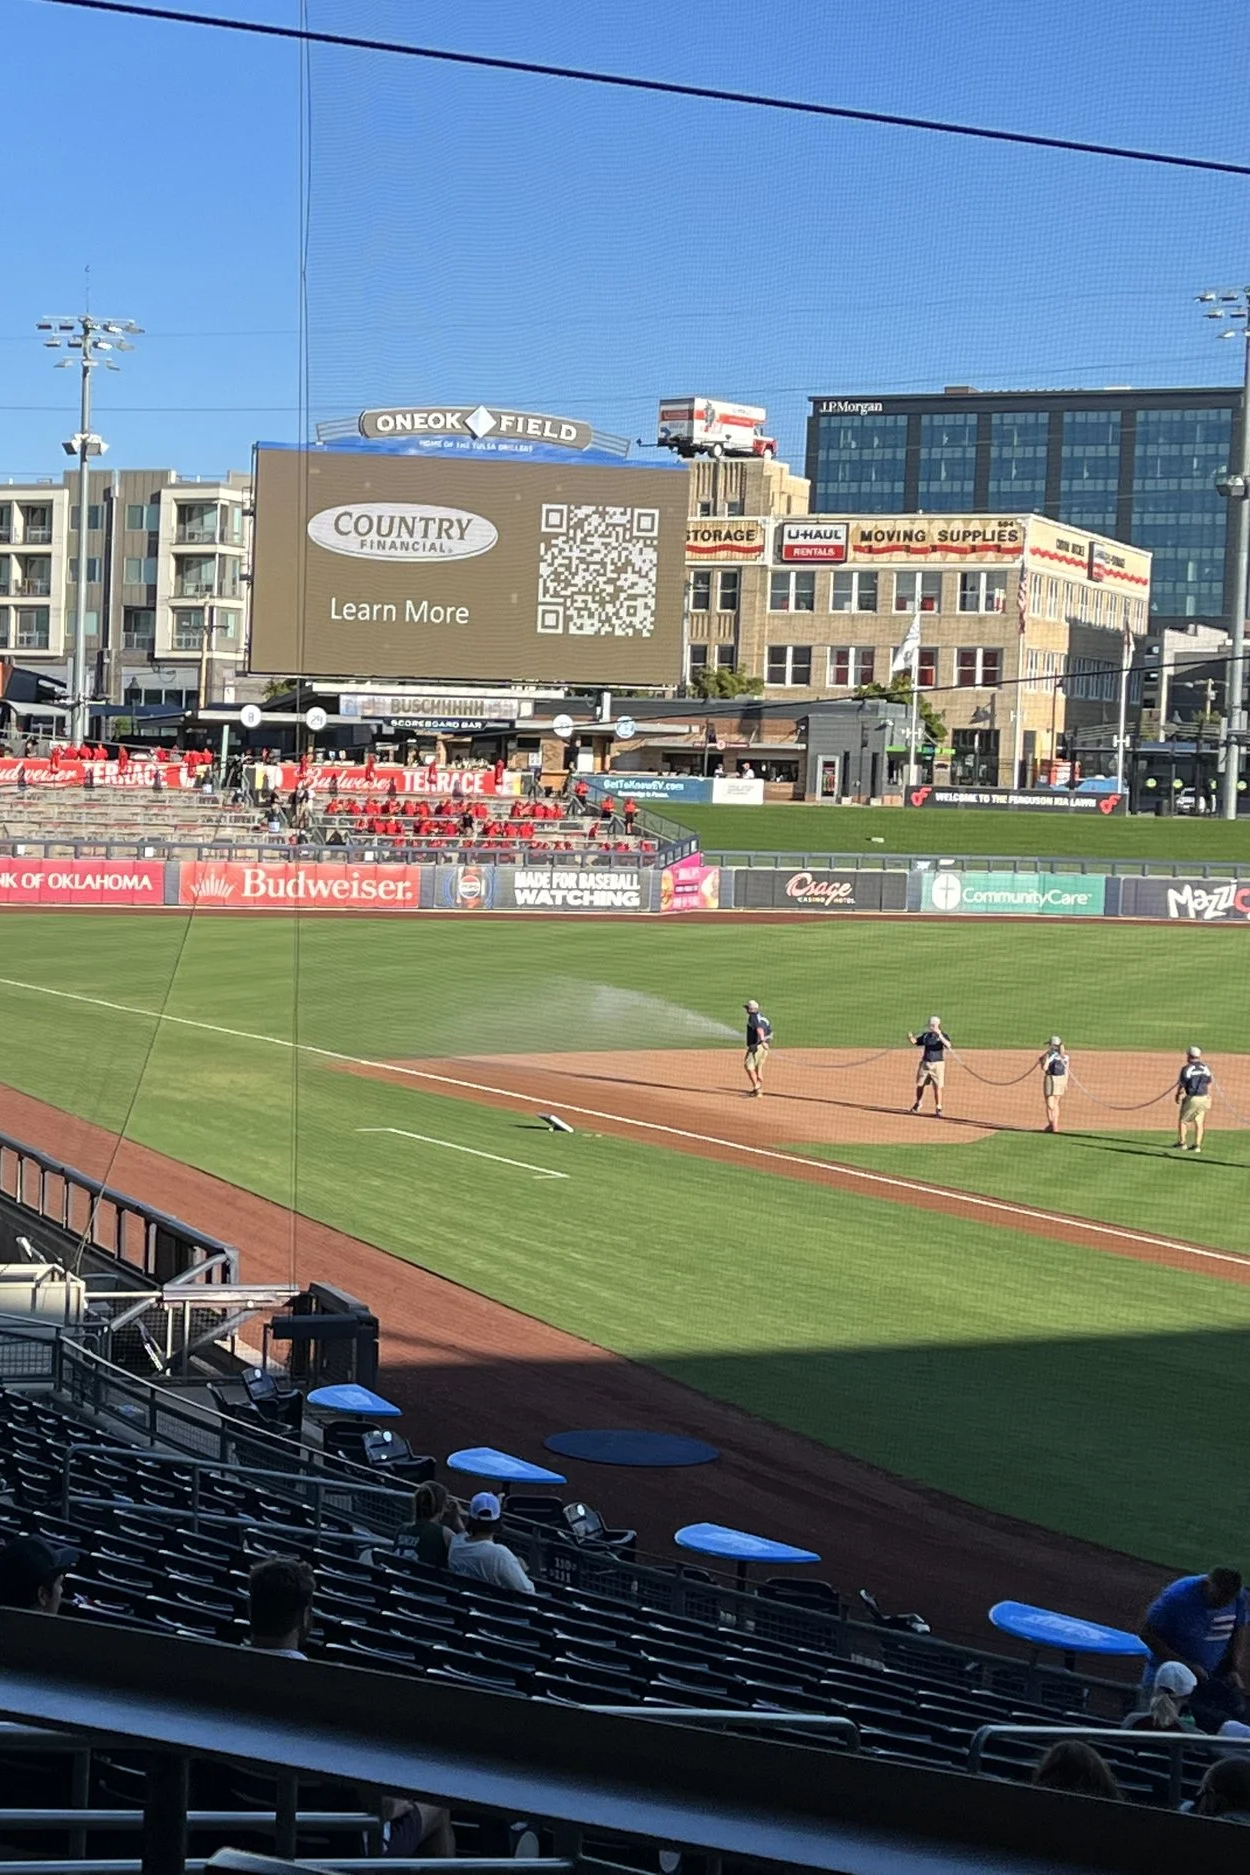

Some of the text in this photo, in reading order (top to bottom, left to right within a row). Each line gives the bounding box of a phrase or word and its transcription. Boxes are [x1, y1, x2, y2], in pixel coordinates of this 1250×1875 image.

[376, 411, 577, 442] ONEOK FIELD
[472, 441, 496, 451] TULSA
[333, 511, 474, 541] COUNTRY
[787, 529, 842, 540] U-HAUL
[860, 530, 1019, 543] MOVING SUPPLIES
[793, 547, 835, 557] RENTALS
[330, 597, 469, 624] Learn More
[390, 719, 483, 729] SCOREBOARD BAR
[935, 792, 978, 803] WELCOME
[979, 793, 991, 803] TO
[992, 794, 1008, 804] THE
[1008, 795, 1054, 806] FERGUSON
[1070, 798, 1097, 808] LAWN
[21, 872, 45, 889] OF
[48, 872, 153, 891] OKLAHOMA
[514, 871, 640, 890] MADE FOR BASEBALL
[785, 872, 853, 906] Osage
[514, 889, 640, 907] WATCHING
[962, 887, 1088, 907] CommunityCare
